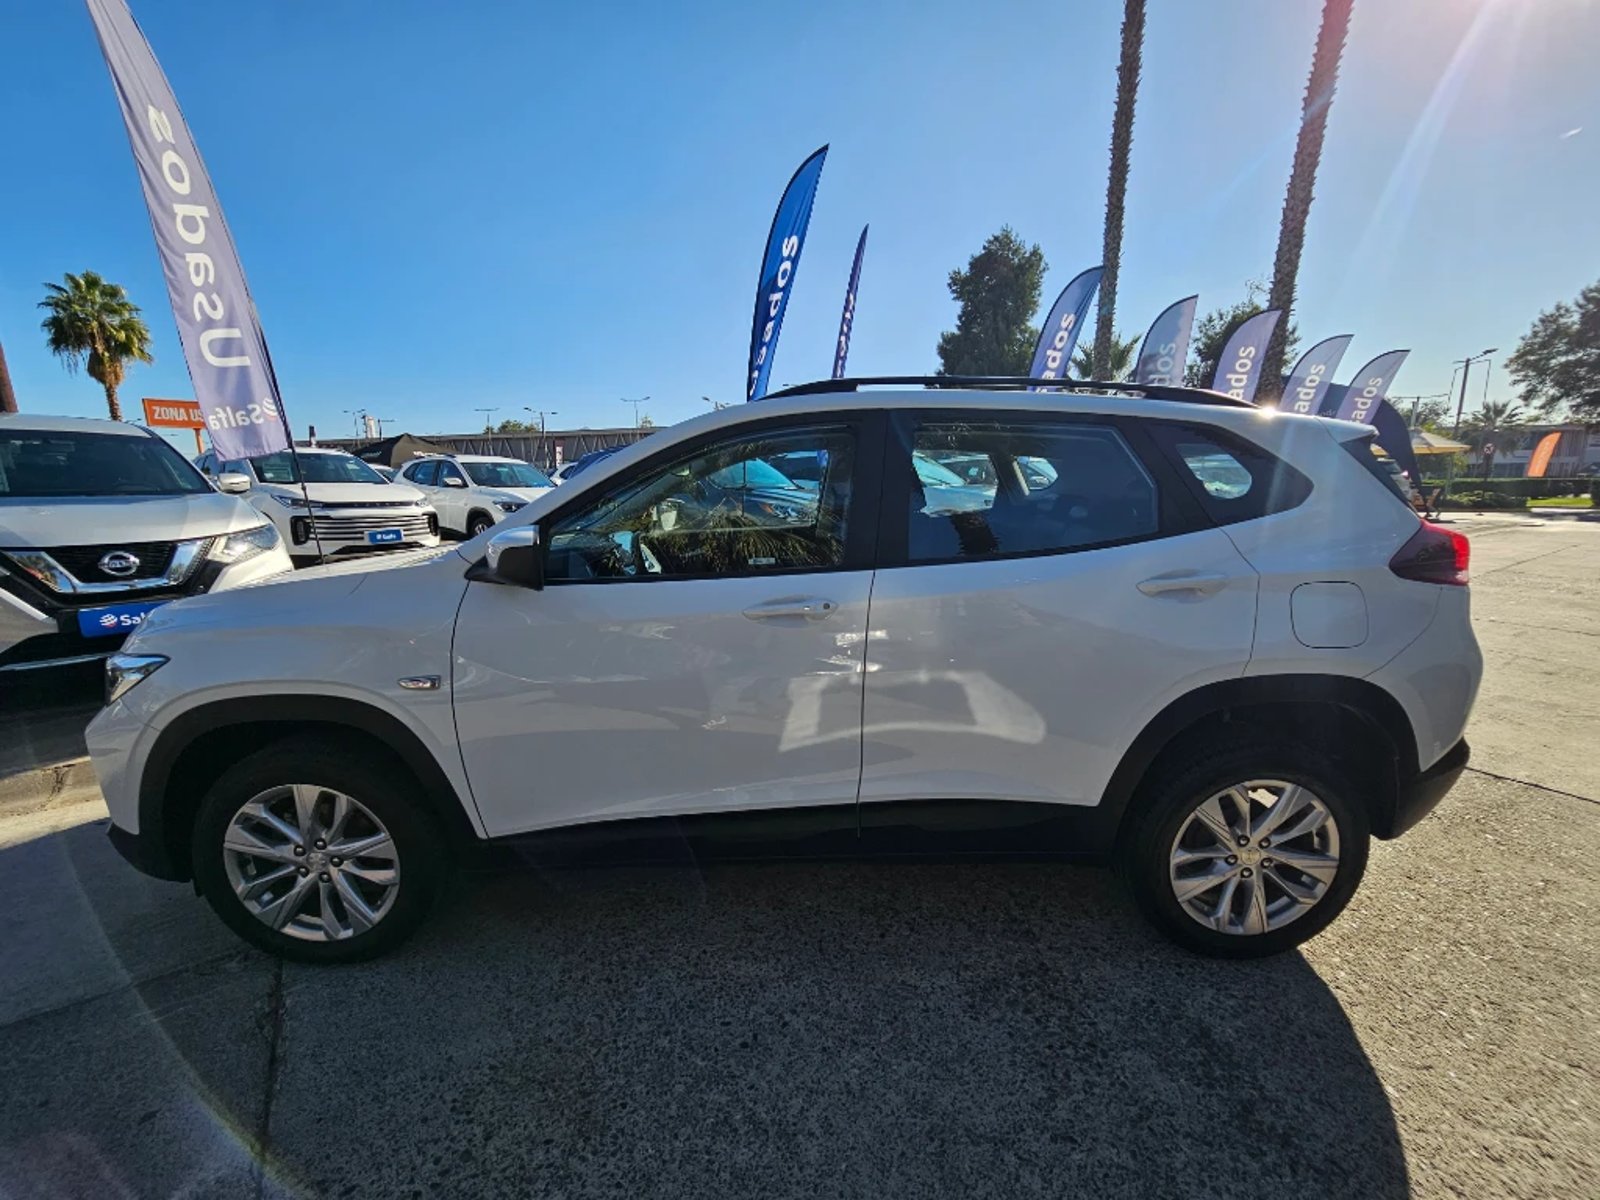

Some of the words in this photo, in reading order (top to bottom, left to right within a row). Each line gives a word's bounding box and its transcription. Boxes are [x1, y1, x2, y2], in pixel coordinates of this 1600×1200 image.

[1294, 364, 1325, 412] ados
[1352, 377, 1382, 423] ados
[152, 406, 187, 420] ZONA
